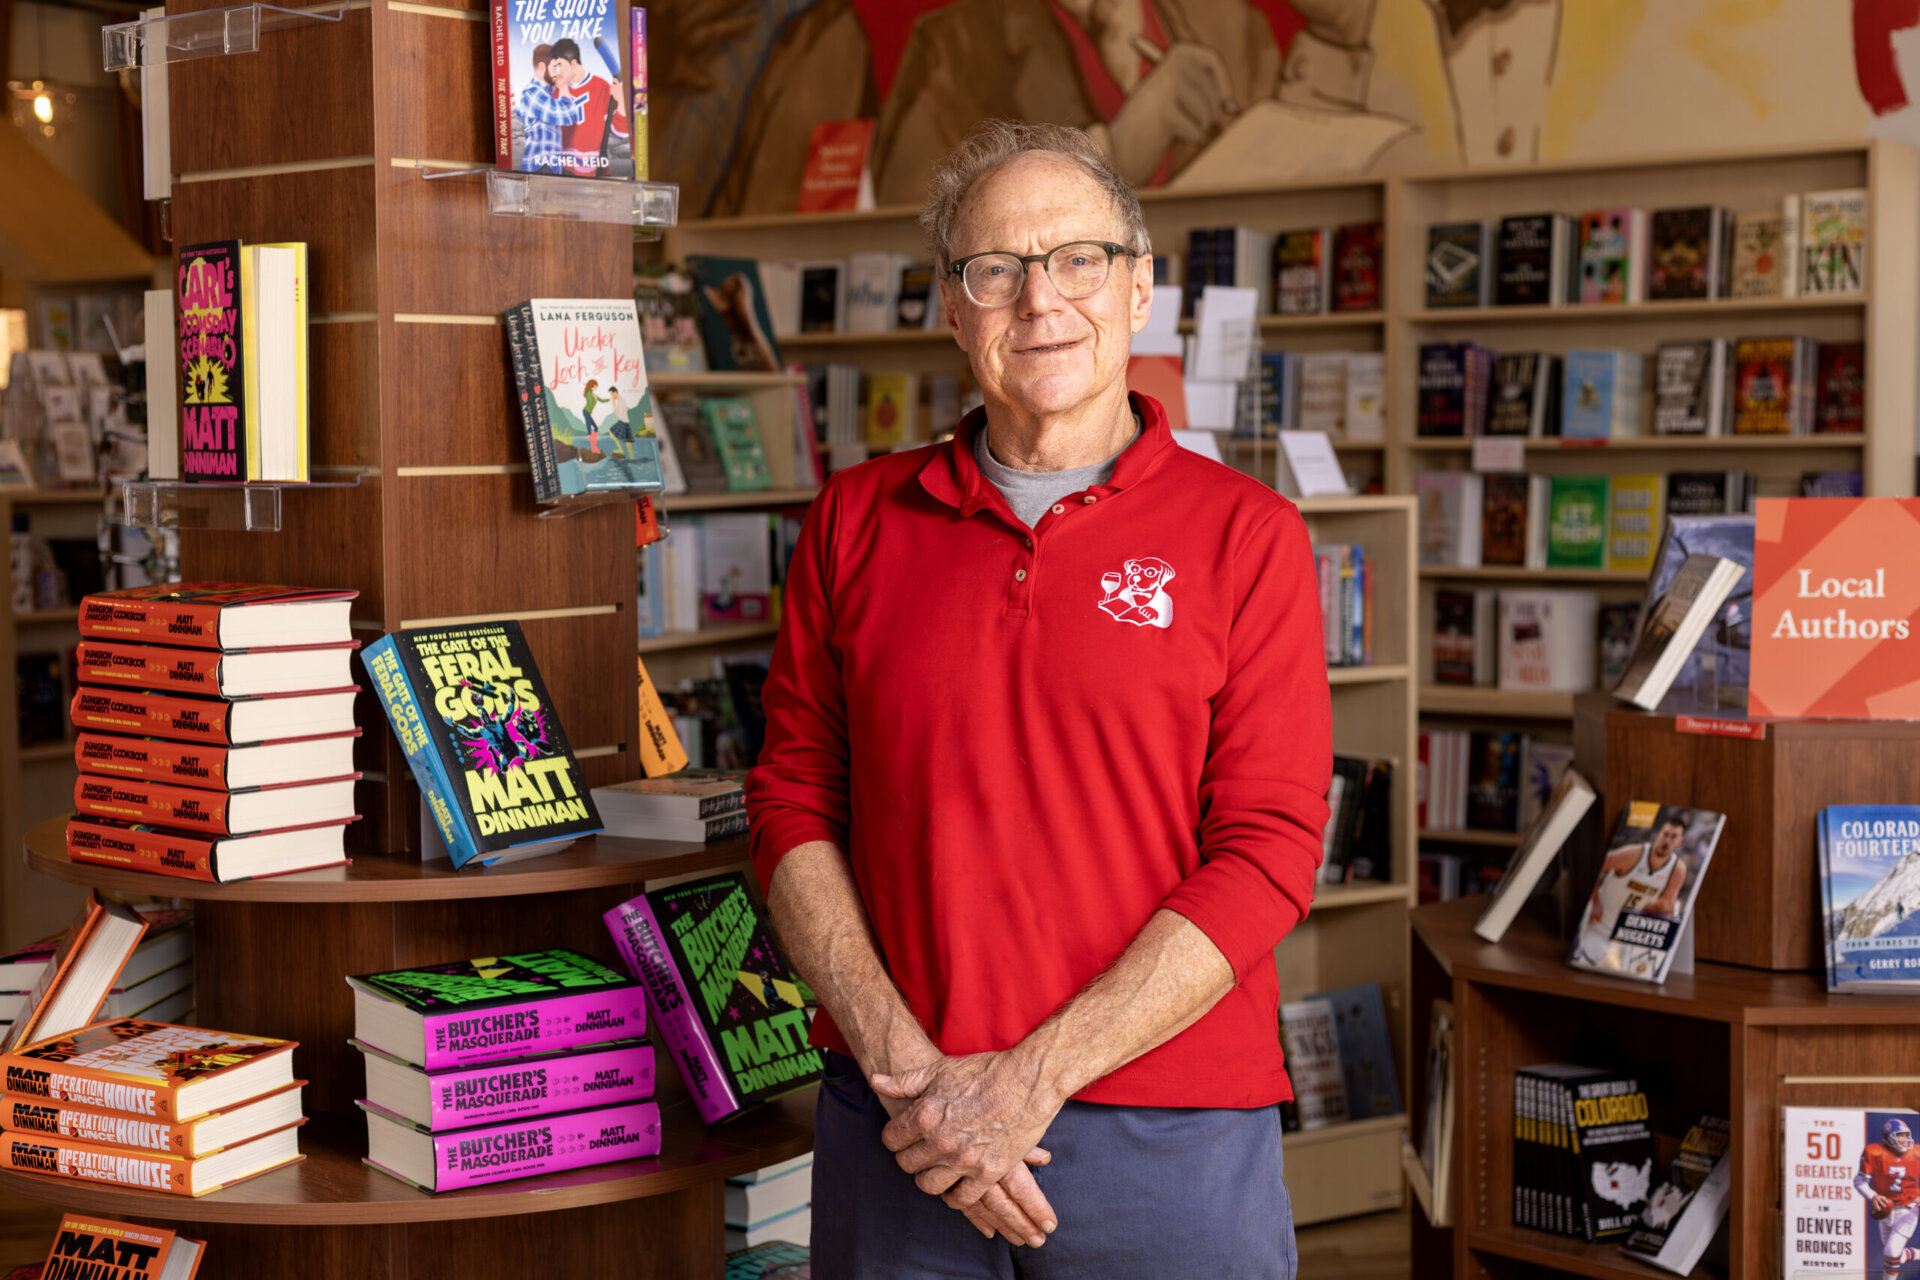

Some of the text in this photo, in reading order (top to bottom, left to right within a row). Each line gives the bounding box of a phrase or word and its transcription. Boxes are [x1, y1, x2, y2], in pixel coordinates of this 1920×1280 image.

[515, 0, 607, 22] THE SHOTS
[495, 6, 504, 42] RACHEL
[520, 17, 604, 45] YOU TAKE
[496, 45, 505, 66] REID
[498, 77, 506, 93] THE
[499, 120, 508, 137] YOU
[500, 137, 509, 157] TAKE
[534, 154, 609, 169] RACHEL REID
[1805, 245, 1863, 293] KIN
[179, 257, 235, 311] CARL'S
[180, 309, 237, 338] DOOMSDAY
[540, 312, 634, 321] LANA FERGUSON
[181, 333, 237, 372] SCENARIO
[564, 325, 616, 359] Under
[550, 347, 643, 392] Loch Key
[183, 405, 238, 451] MATT
[535, 397, 543, 424] LANA
[539, 425, 553, 478] FERGUSON
[184, 452, 237, 475] DINNIMAN
[1798, 568, 1885, 598] Local
[114, 609, 147, 622] COOKBOOK
[176, 614, 194, 625] MATT
[1771, 608, 1910, 640] Authors
[168, 624, 203, 636] DINNIMAN
[413, 627, 505, 643] NEW YORK TIMES BESTSELLER
[416, 634, 511, 657] THE GATE OF THE
[112, 655, 146, 668] COOKBOOK
[177, 661, 195, 672] MATT
[421, 647, 523, 690] FERAL
[169, 670, 204, 682] DINNIMAN
[111, 701, 147, 716] COOKBOOK
[371, 654, 419, 756] FERAL GODS
[382, 647, 429, 748] THE GATE OF THE
[434, 678, 541, 722] GODS
[172, 719, 209, 733] DINNIMAN
[180, 710, 200, 722] MATT
[113, 748, 148, 762] COOKBOOK
[181, 756, 199, 767] MATT
[173, 764, 209, 778] DINNIMAN
[465, 756, 577, 814] MATT
[113, 790, 149, 804] COOKBOOK
[181, 799, 200, 811] MATT
[173, 808, 210, 822] DINNIMAN
[427, 789, 455, 845] DINNIMAN
[437, 797, 454, 824] MATT
[475, 797, 590, 837] DINNIMAN
[101, 838, 136, 852] COOKBOOK
[167, 848, 185, 859] MATT
[160, 856, 196, 871] DINNIMAN
[671, 911, 696, 938] THE
[679, 884, 749, 982] BUTCHER'S
[1625, 914, 1671, 934] DENVER
[1615, 926, 1666, 948] NUGGETS
[1846, 939, 1870, 948] FROM
[1875, 938, 1903, 947] HIKES
[622, 908, 685, 1009] THE BUTCHER'S
[699, 904, 758, 1026] MASQUERADE
[1869, 958, 1901, 970] GERRY
[623, 926, 672, 1016] MASQUERADE
[575, 1017, 625, 1033] DINNIMAN
[586, 1009, 611, 1022] MATT
[436, 1009, 539, 1051] THE BUTCHER'S
[449, 1026, 541, 1053] MASQUERADE
[719, 1008, 812, 1073] MATT
[7, 1065, 51, 1082] MATT
[594, 1069, 621, 1082] MATT
[735, 1049, 825, 1095] DINNIMAN
[7, 1079, 50, 1097] DINNIMAN
[51, 1073, 104, 1098] OPERATION
[442, 1068, 547, 1110] THE BUTCHER'S
[583, 1076, 634, 1092] DINNIMAN
[103, 1082, 156, 1116] HOUSE
[456, 1086, 548, 1112] MASQUERADE
[1574, 1092, 1649, 1128] COLORADO
[13, 1103, 60, 1120] MATT
[59, 1109, 117, 1134] OPERATION
[13, 1115, 59, 1135] DINNIMAN
[116, 1118, 172, 1152] HOUSE
[600, 1125, 626, 1139] MATT
[1814, 1120, 1835, 1128] THE
[11, 1141, 59, 1159] MATT
[448, 1126, 553, 1170] THE BUTCHER'S
[589, 1133, 640, 1150] DINNIMAN
[1807, 1132, 1841, 1161] 50
[12, 1152, 58, 1173] DINNIMAN
[59, 1148, 117, 1173] OPERATION
[461, 1144, 554, 1172] MASQUERADE
[117, 1156, 173, 1191] HOUSE
[1795, 1164, 1853, 1180] GREATEST
[1796, 1183, 1853, 1201] PLAYERS
[1796, 1217, 1853, 1236] DENVER
[54, 1231, 160, 1270] MATT
[1796, 1239, 1853, 1256] BRONCOS
[45, 1256, 150, 1280] DINNIM
[1802, 1260, 1846, 1269] HISTORY
